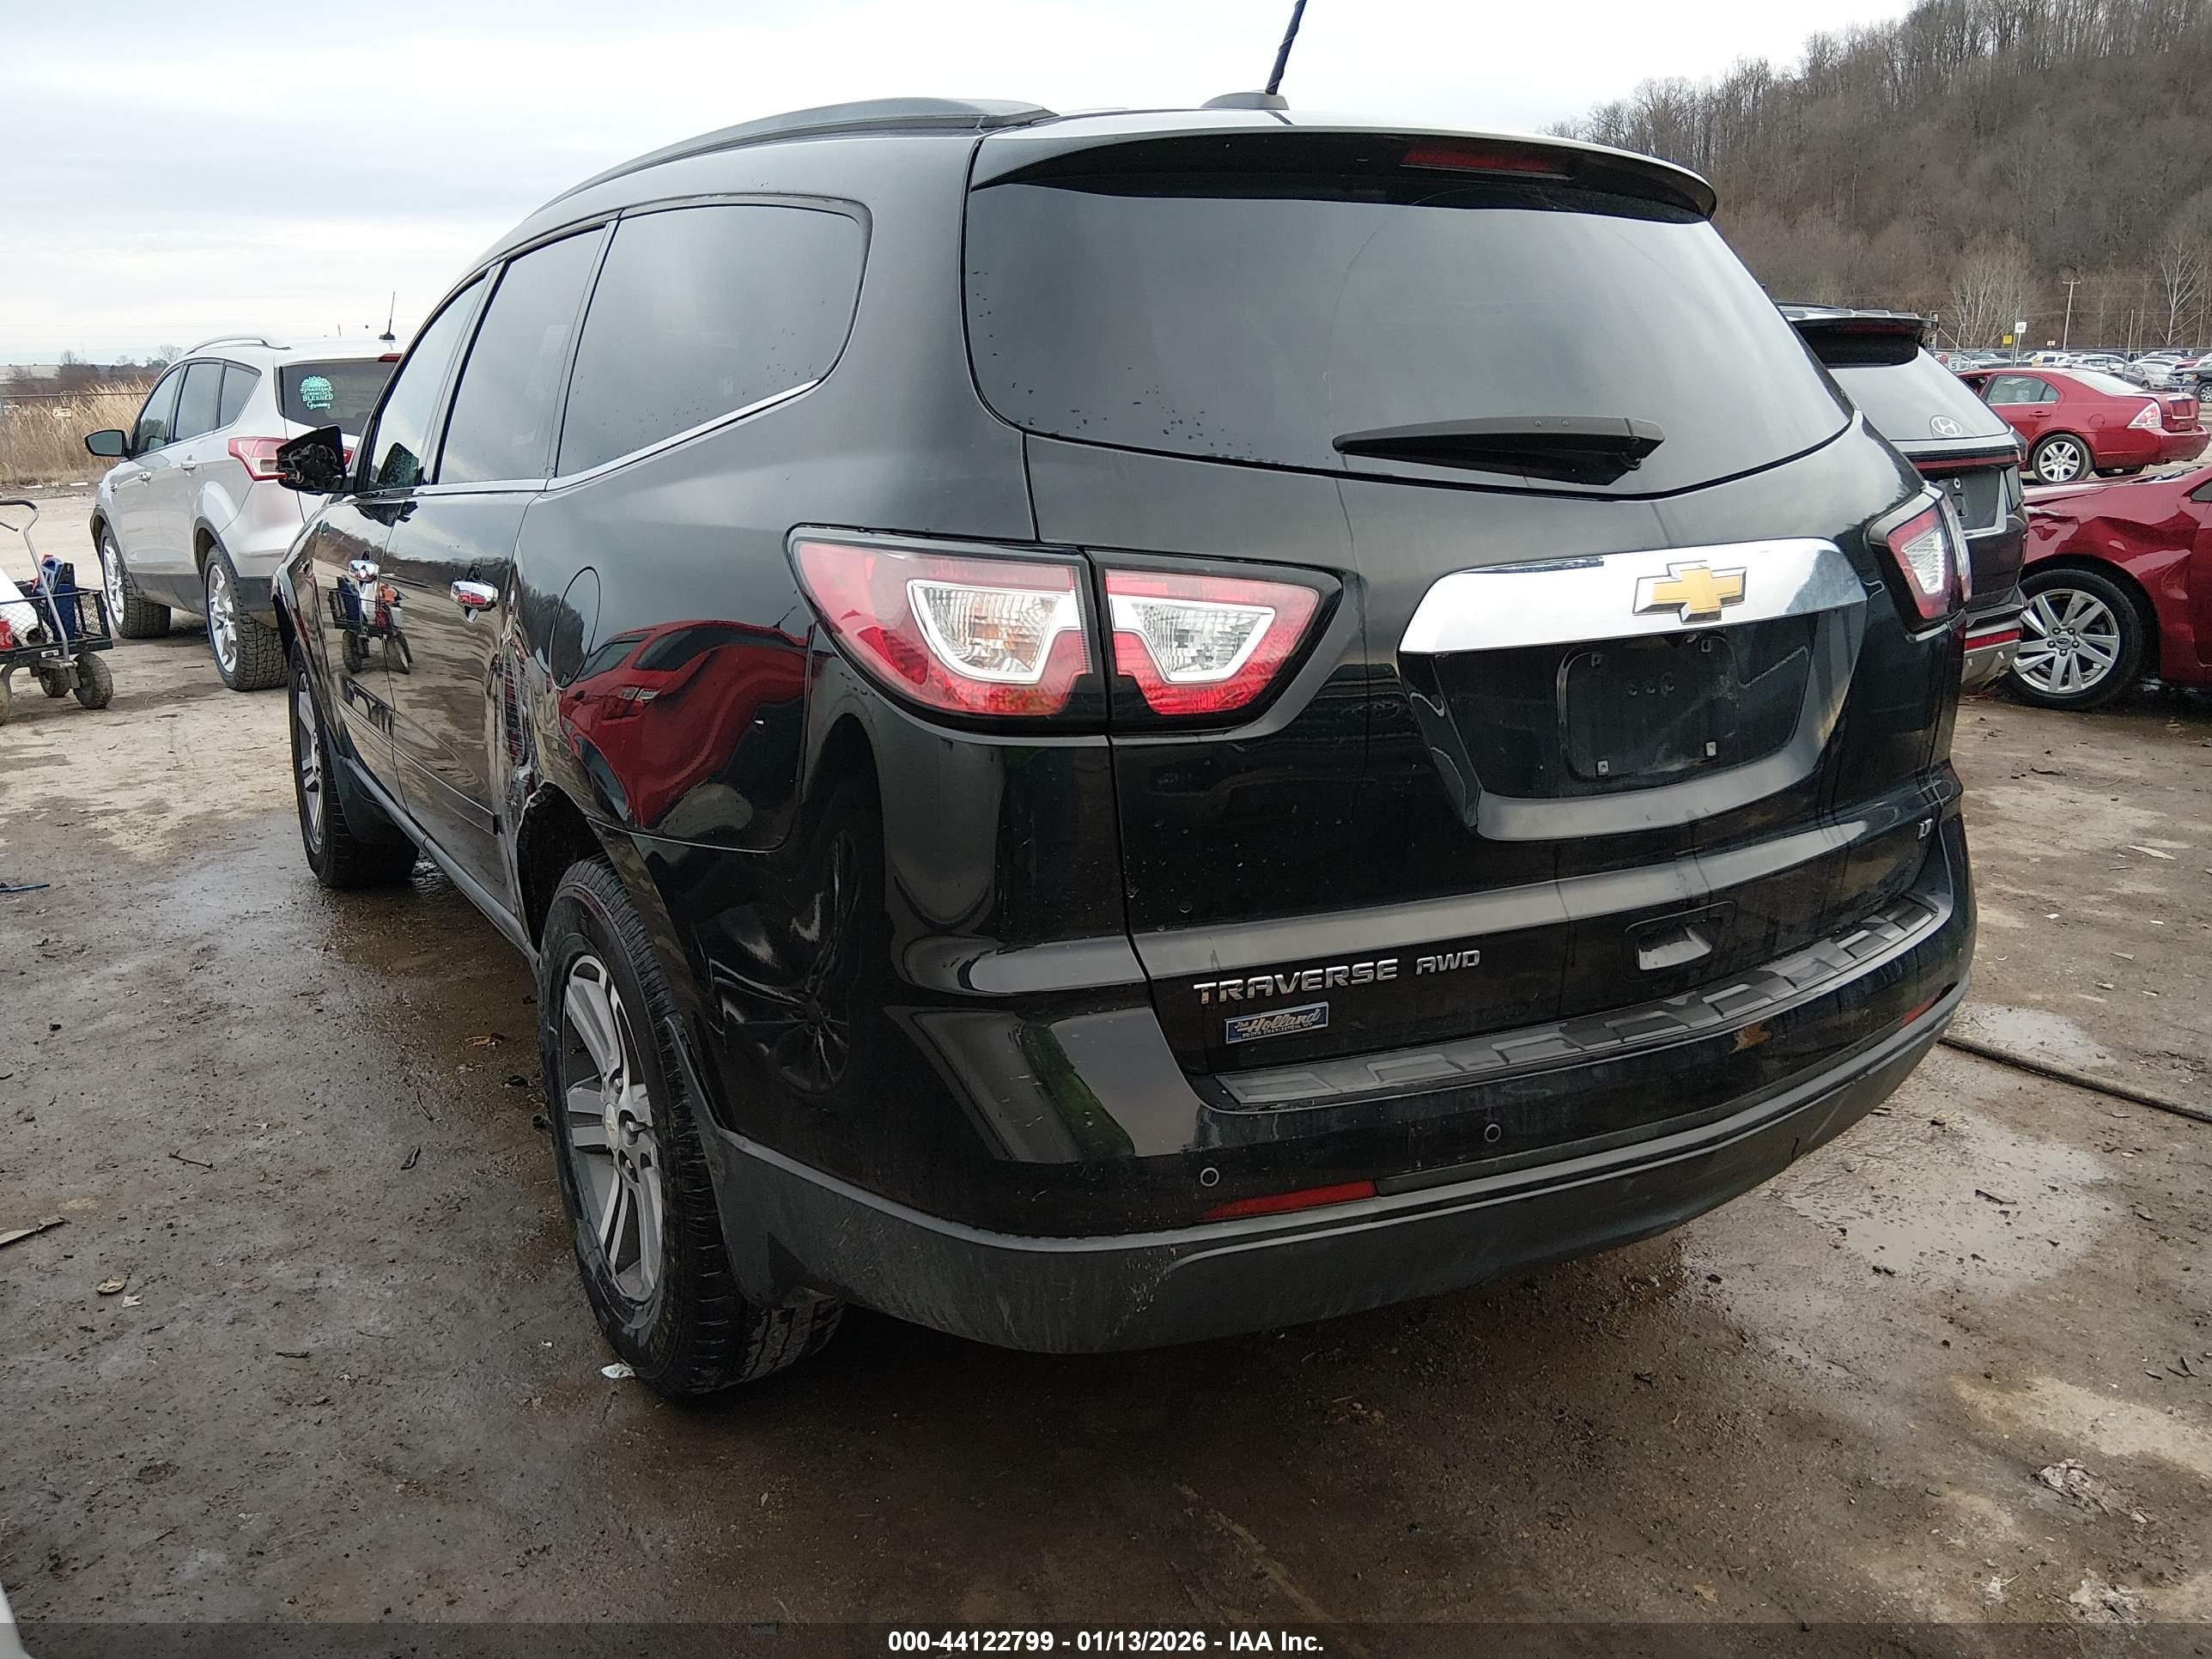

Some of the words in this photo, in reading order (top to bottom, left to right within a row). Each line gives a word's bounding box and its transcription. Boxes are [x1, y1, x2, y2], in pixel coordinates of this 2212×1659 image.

[302, 393, 334, 402] BLESSED
[1193, 958, 1399, 1005] TRAVERSE
[1415, 950, 1481, 975] AWD
[1247, 1008, 1322, 1032] Holland
